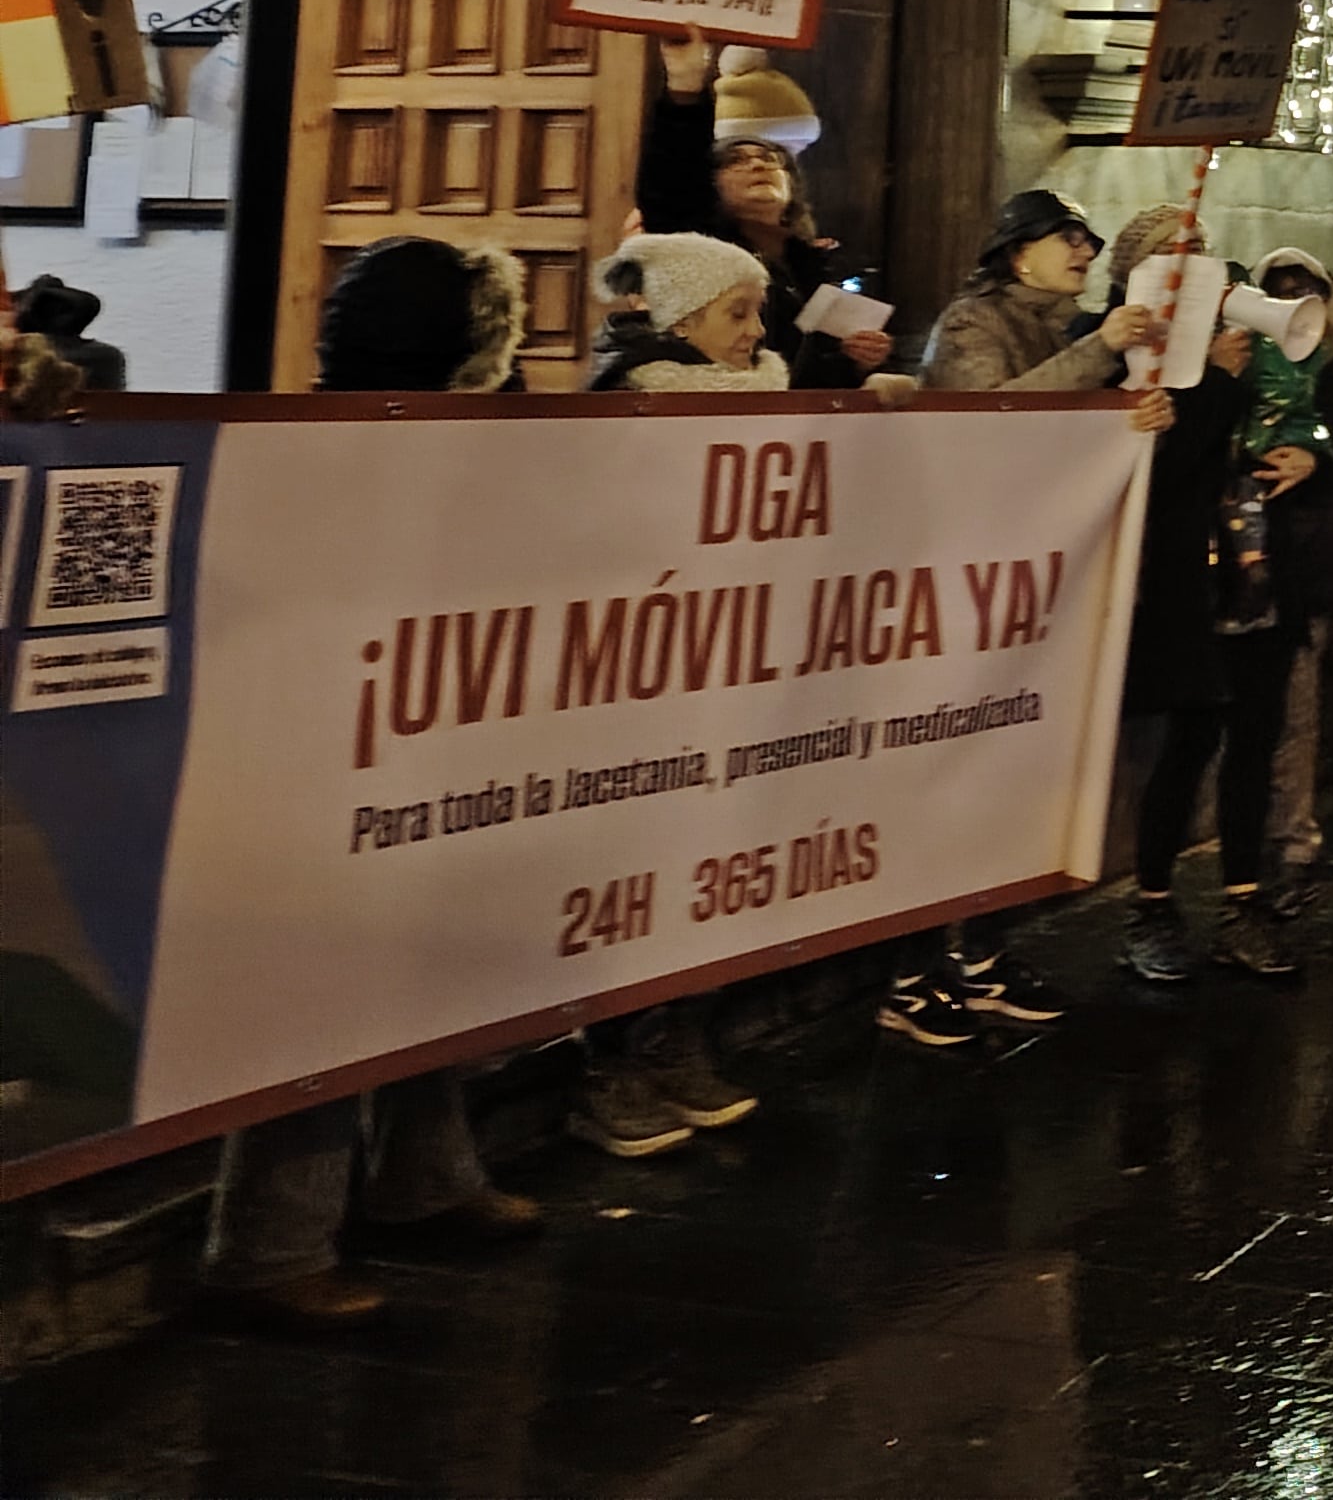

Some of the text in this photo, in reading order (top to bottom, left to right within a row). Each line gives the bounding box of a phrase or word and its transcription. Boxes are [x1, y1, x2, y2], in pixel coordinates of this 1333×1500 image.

[696, 440, 831, 545] DGA
[353, 550, 1065, 770] ¡UVI MÓVIL JACA YA!
[349, 687, 1044, 854] Para toda la Jacetania, presencial y medicalizada
[557, 816, 882, 958] 24H 365 DÍAS
